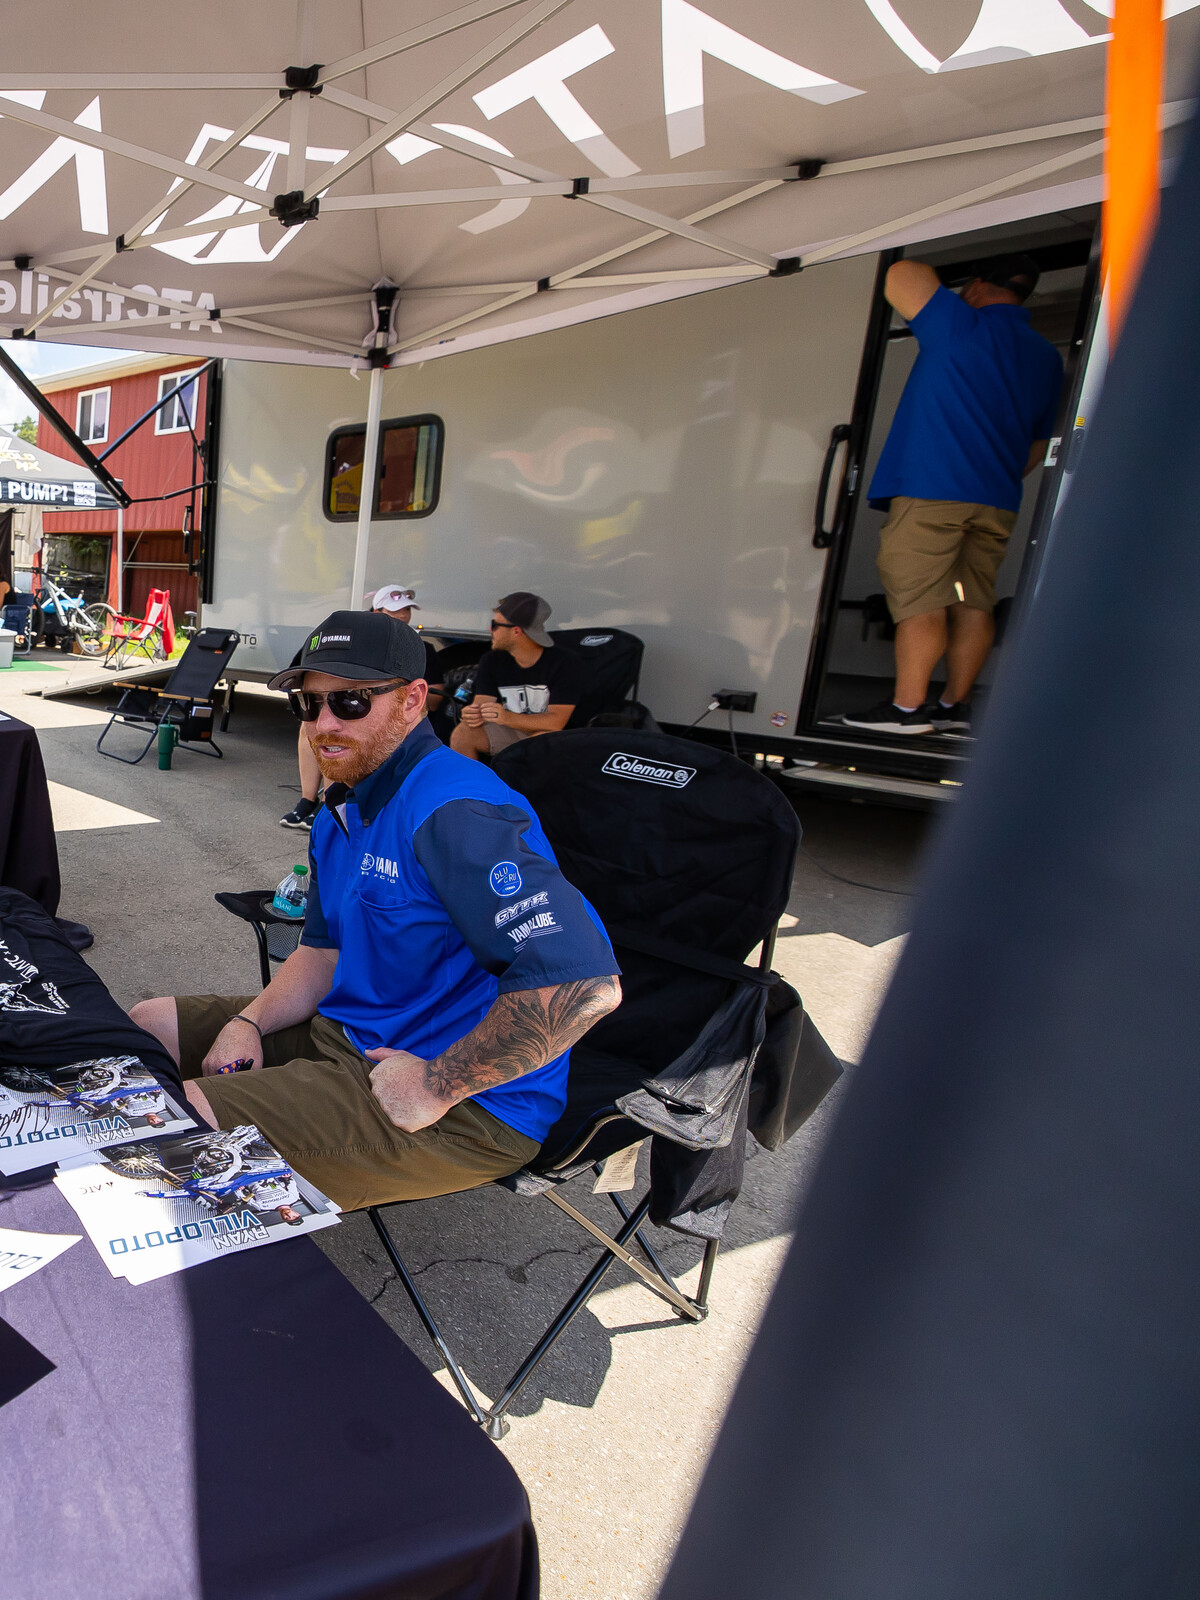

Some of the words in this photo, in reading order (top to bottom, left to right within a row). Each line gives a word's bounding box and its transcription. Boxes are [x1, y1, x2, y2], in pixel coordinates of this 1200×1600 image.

[7, 481, 69, 502] PUMP!
[611, 755, 674, 780] Coleman
[376, 856, 399, 878] YAMA
[86, 1126, 136, 1145] RYAN
[108, 1209, 263, 1256] VILLOPOTO
[213, 1224, 271, 1250] RYAN
